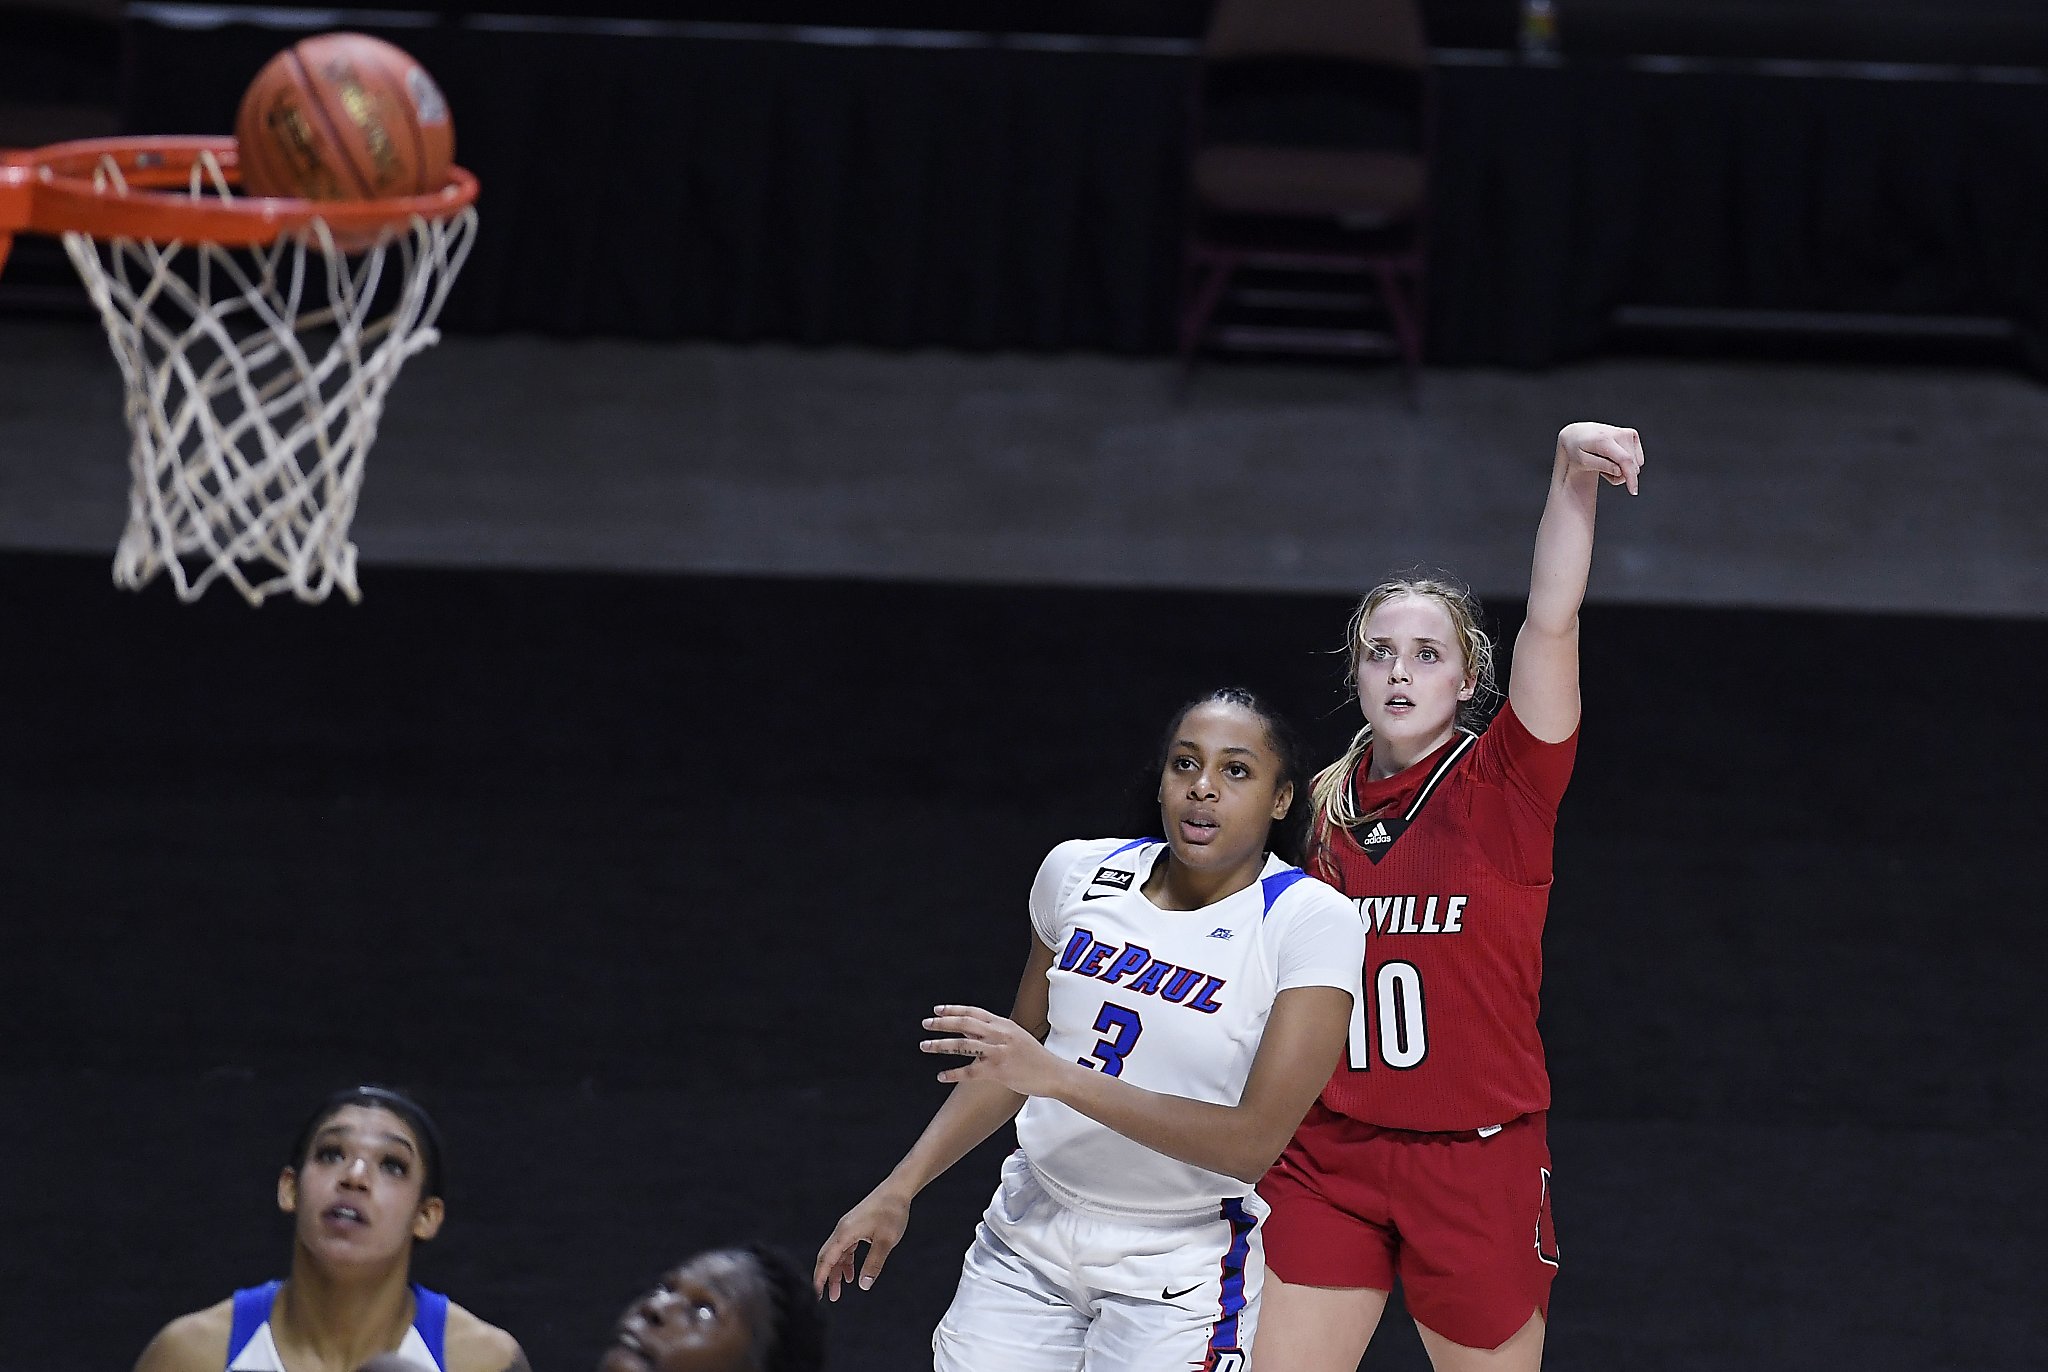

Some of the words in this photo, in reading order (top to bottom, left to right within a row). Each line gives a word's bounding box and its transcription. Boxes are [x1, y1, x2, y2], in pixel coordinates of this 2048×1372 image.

[1364, 834, 1392, 845] adidas
[1099, 870, 1132, 883] BLM
[1346, 959, 1429, 1072] 10
[1077, 1001, 1143, 1078] 3
